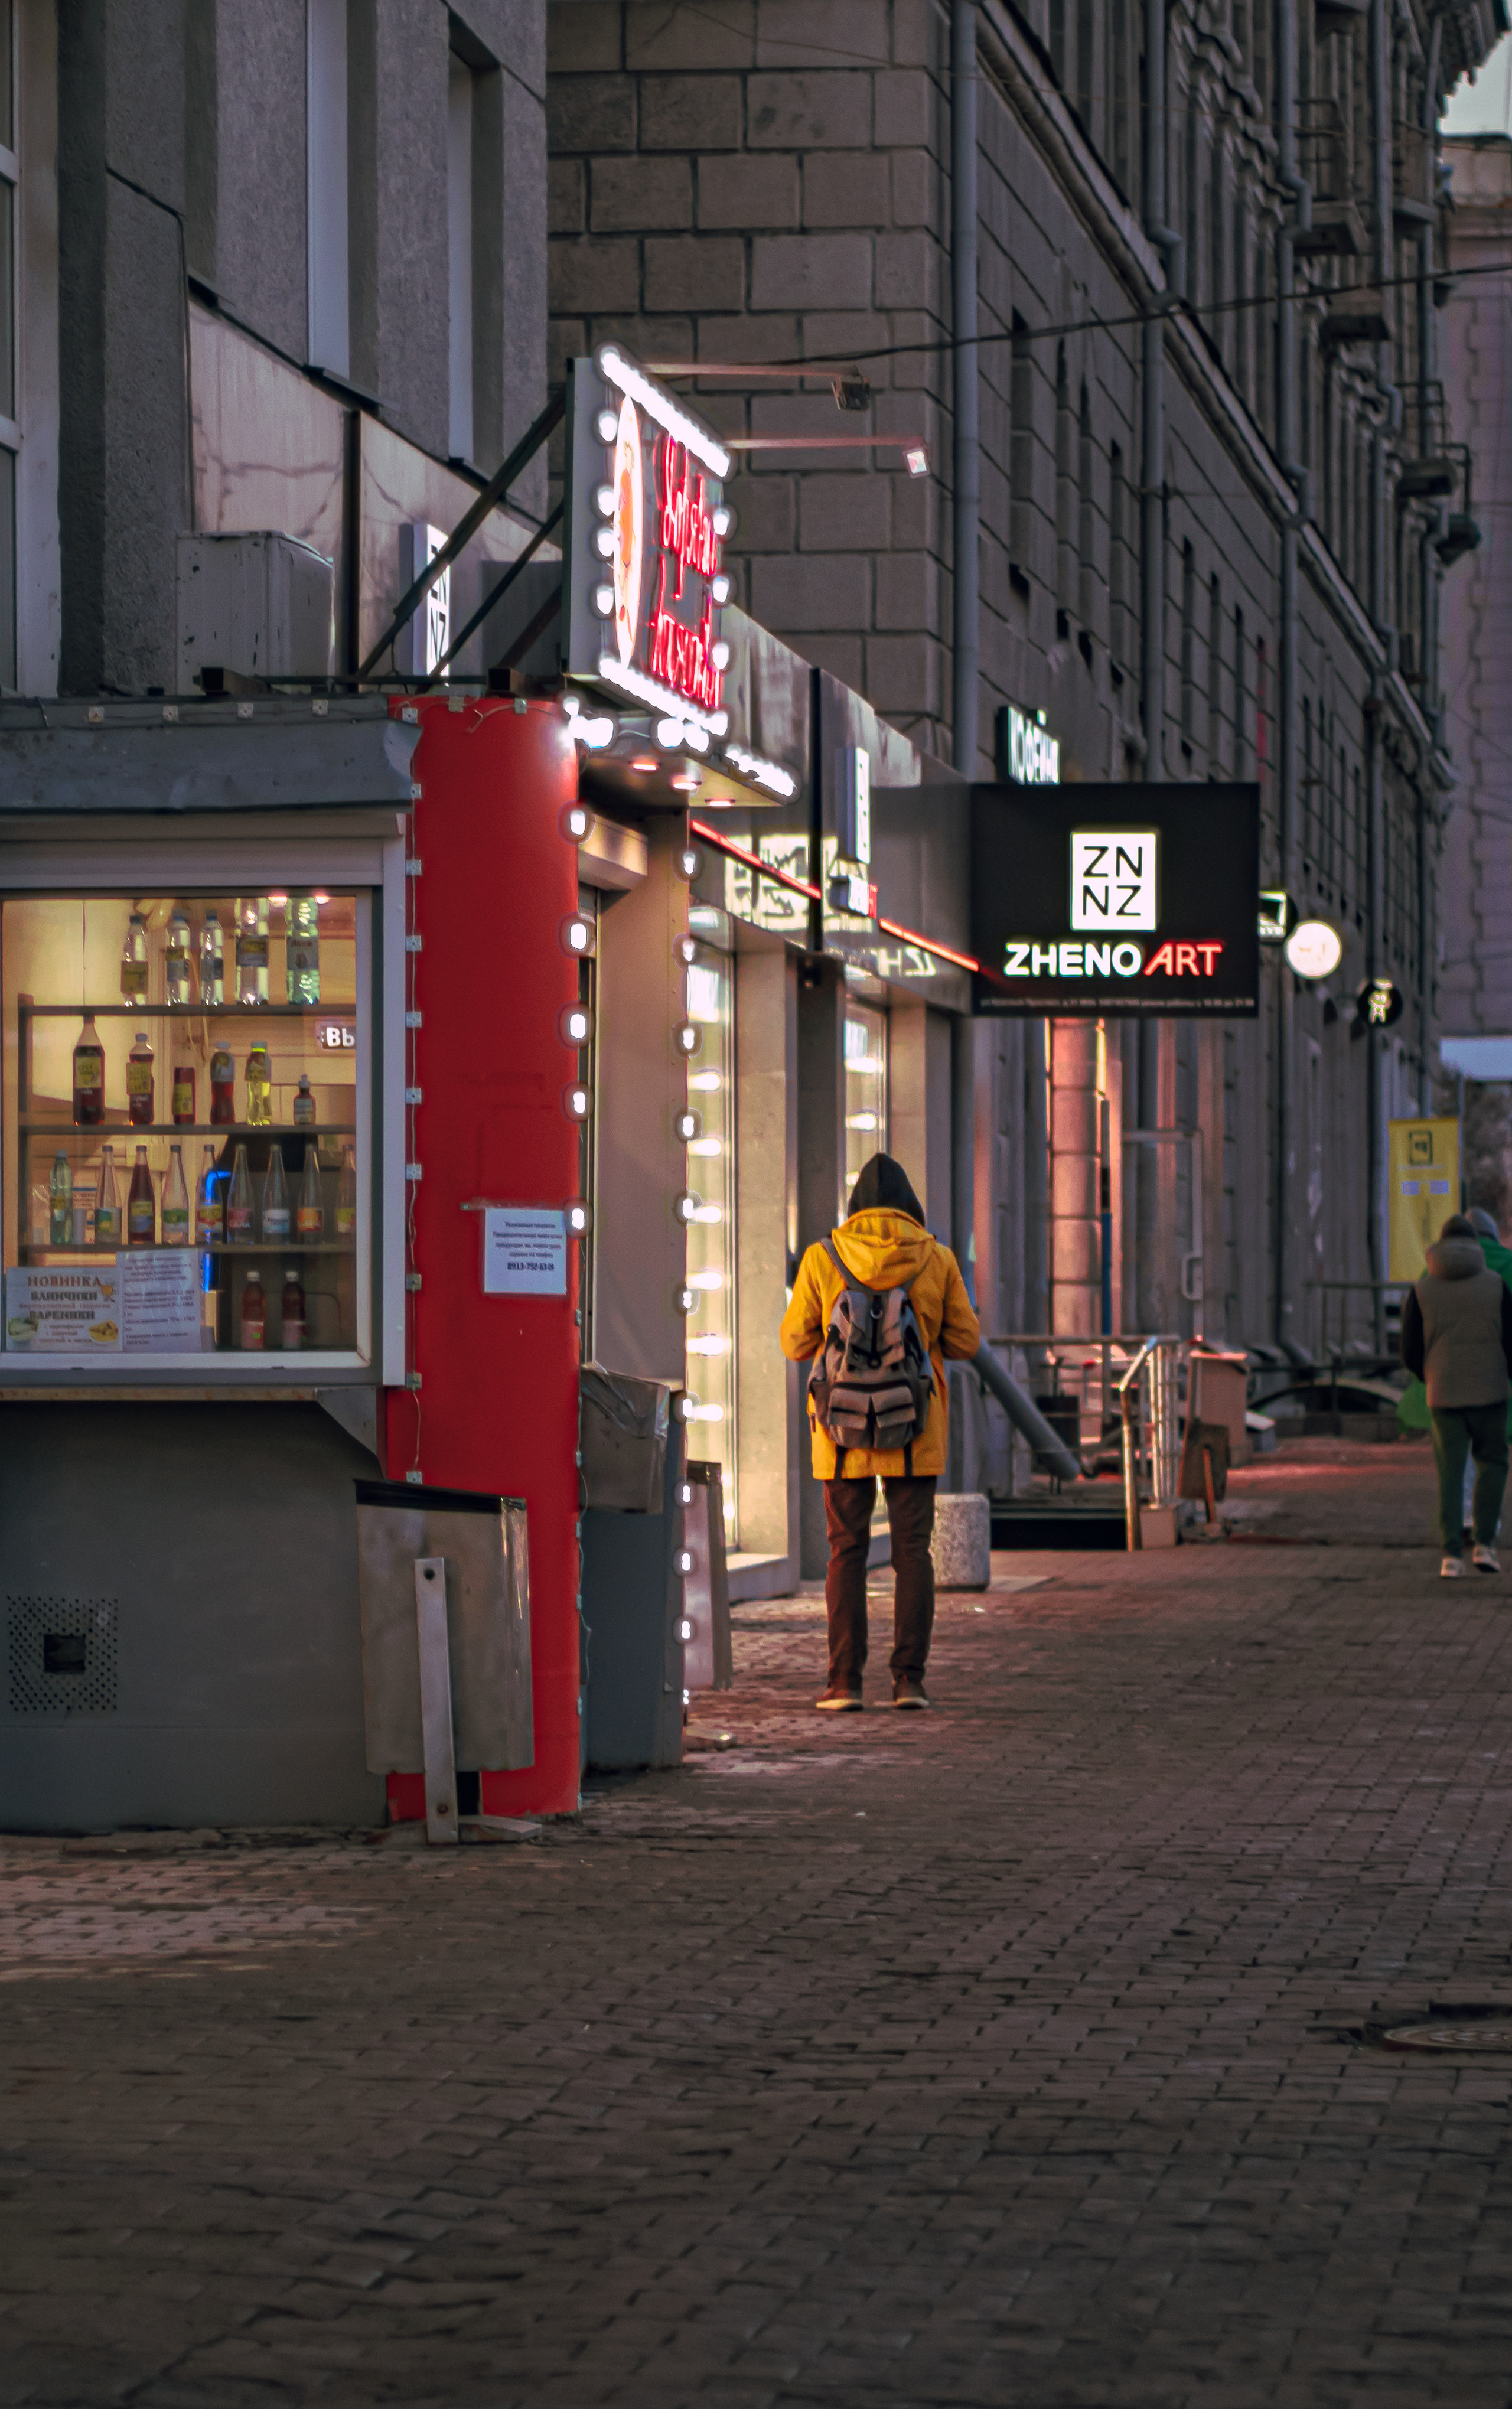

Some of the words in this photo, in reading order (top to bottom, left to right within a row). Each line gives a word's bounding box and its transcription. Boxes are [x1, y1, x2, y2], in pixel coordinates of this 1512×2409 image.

[1083, 846, 1143, 878] ZN
[1083, 885, 1142, 916] NZ
[28, 1276, 102, 1287] НОВИНКА
[30, 1310, 94, 1319] ВАРЕНИКИ
